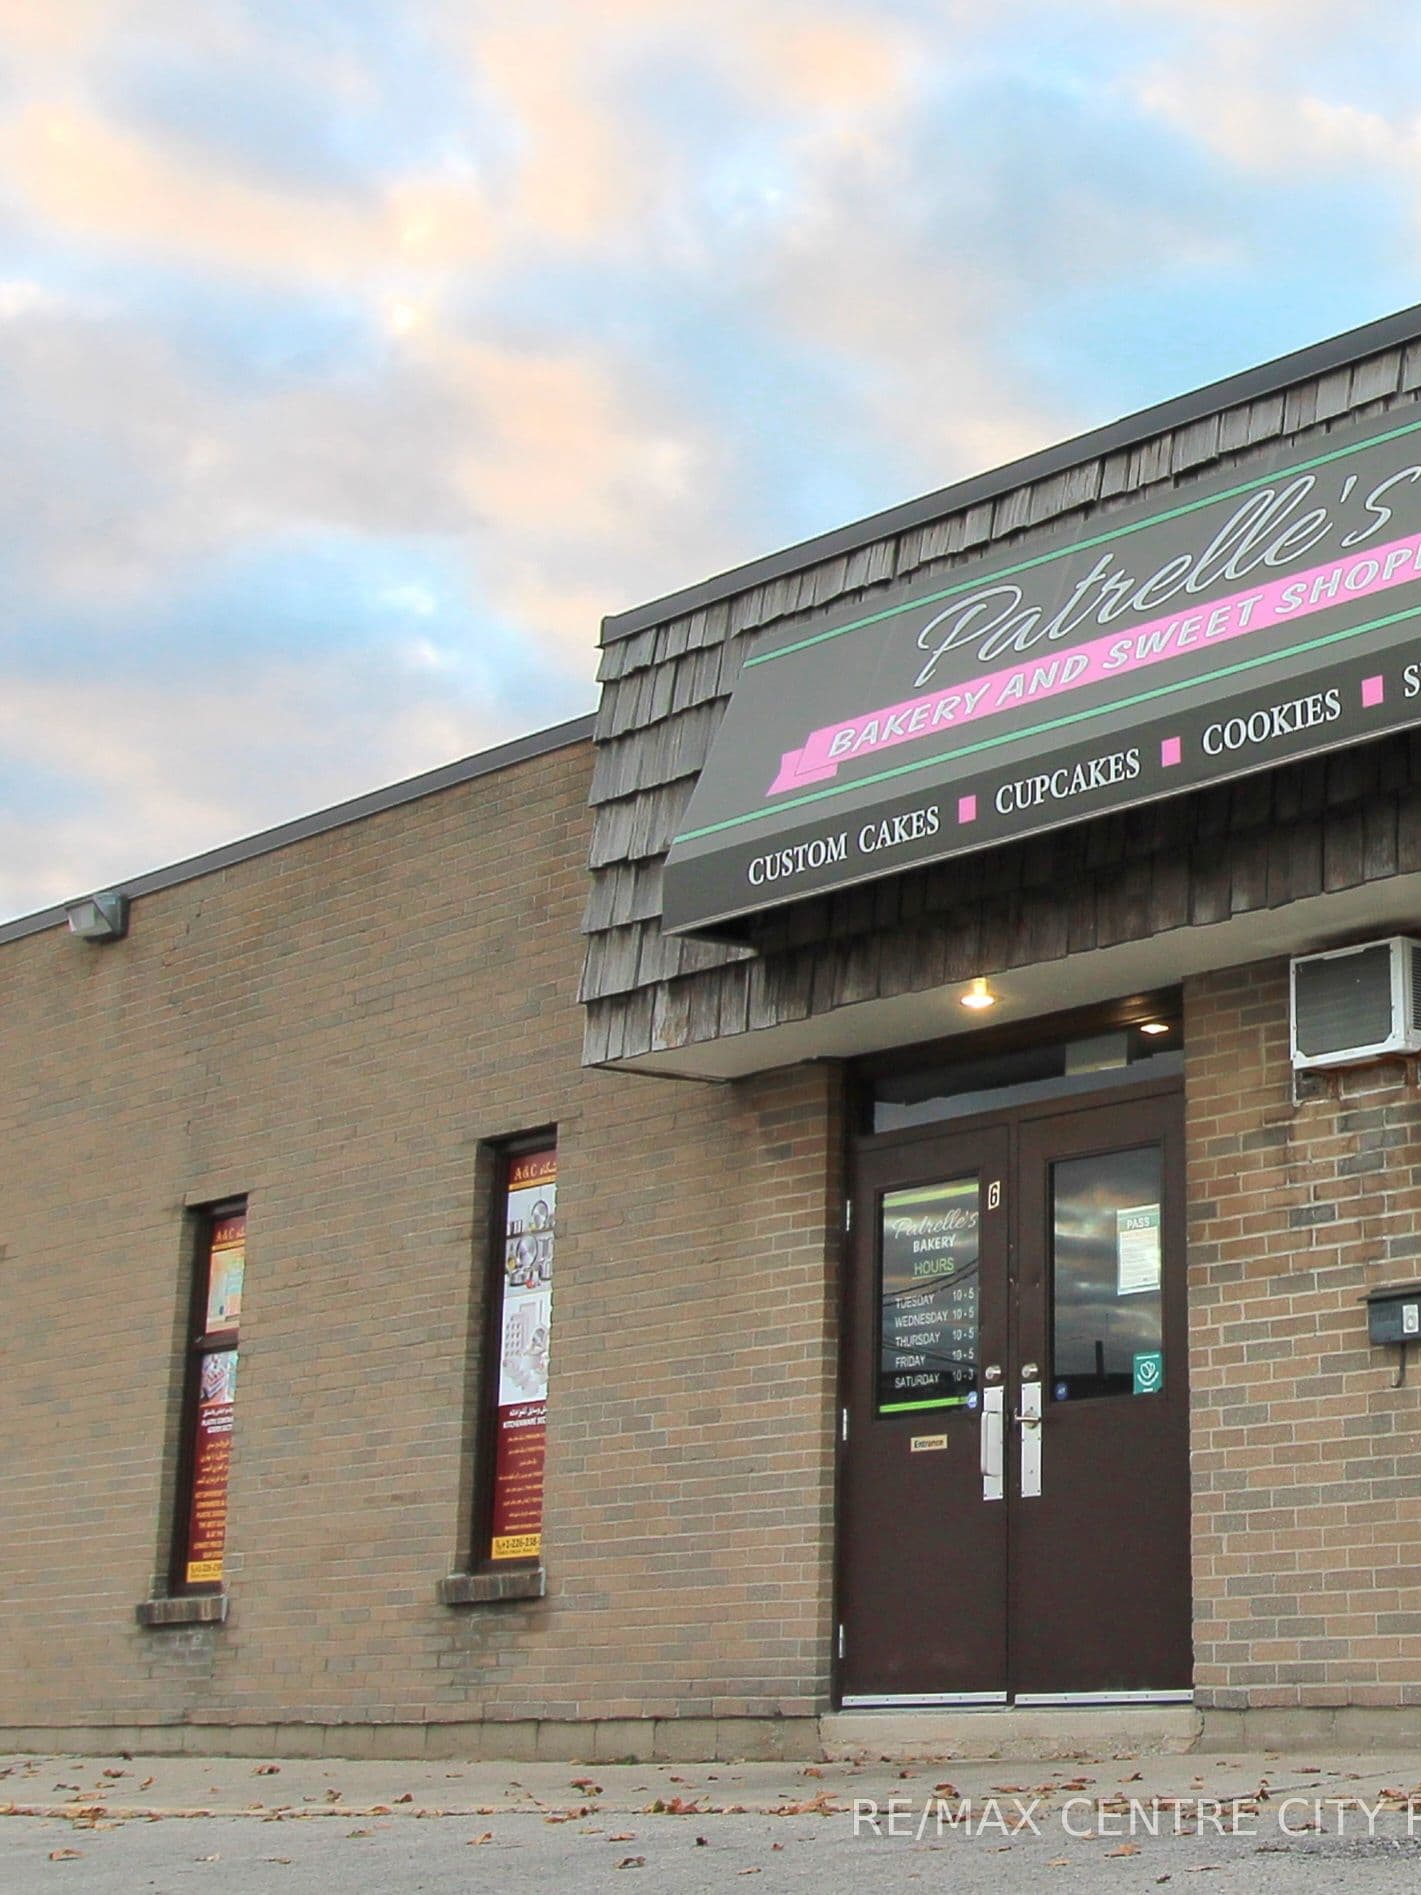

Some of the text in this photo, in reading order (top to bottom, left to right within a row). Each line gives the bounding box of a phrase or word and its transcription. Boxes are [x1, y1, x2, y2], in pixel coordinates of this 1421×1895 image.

[827, 683, 992, 757] BAKERY
[996, 655, 1089, 705] AND
[1102, 594, 1263, 669] SWEET
[748, 831, 848, 885] CUSTOM
[858, 806, 940, 853] CAKES
[995, 748, 1141, 814] CUPCAKES
[1202, 688, 1342, 755] COOKIES
[990, 1183, 999, 1207] 6
[892, 1208, 978, 1239] Patrelle's
[1127, 1217, 1150, 1229] PASS
[913, 1234, 956, 1253] BAKERY
[914, 1257, 954, 1275] HOURS
[895, 1293, 935, 1309] TUESDAY
[895, 1310, 948, 1328] WEDNESDAY
[895, 1331, 940, 1347] THURSDAY
[895, 1355, 926, 1368] FRIDAY
[895, 1372, 940, 1389] SATURDAY
